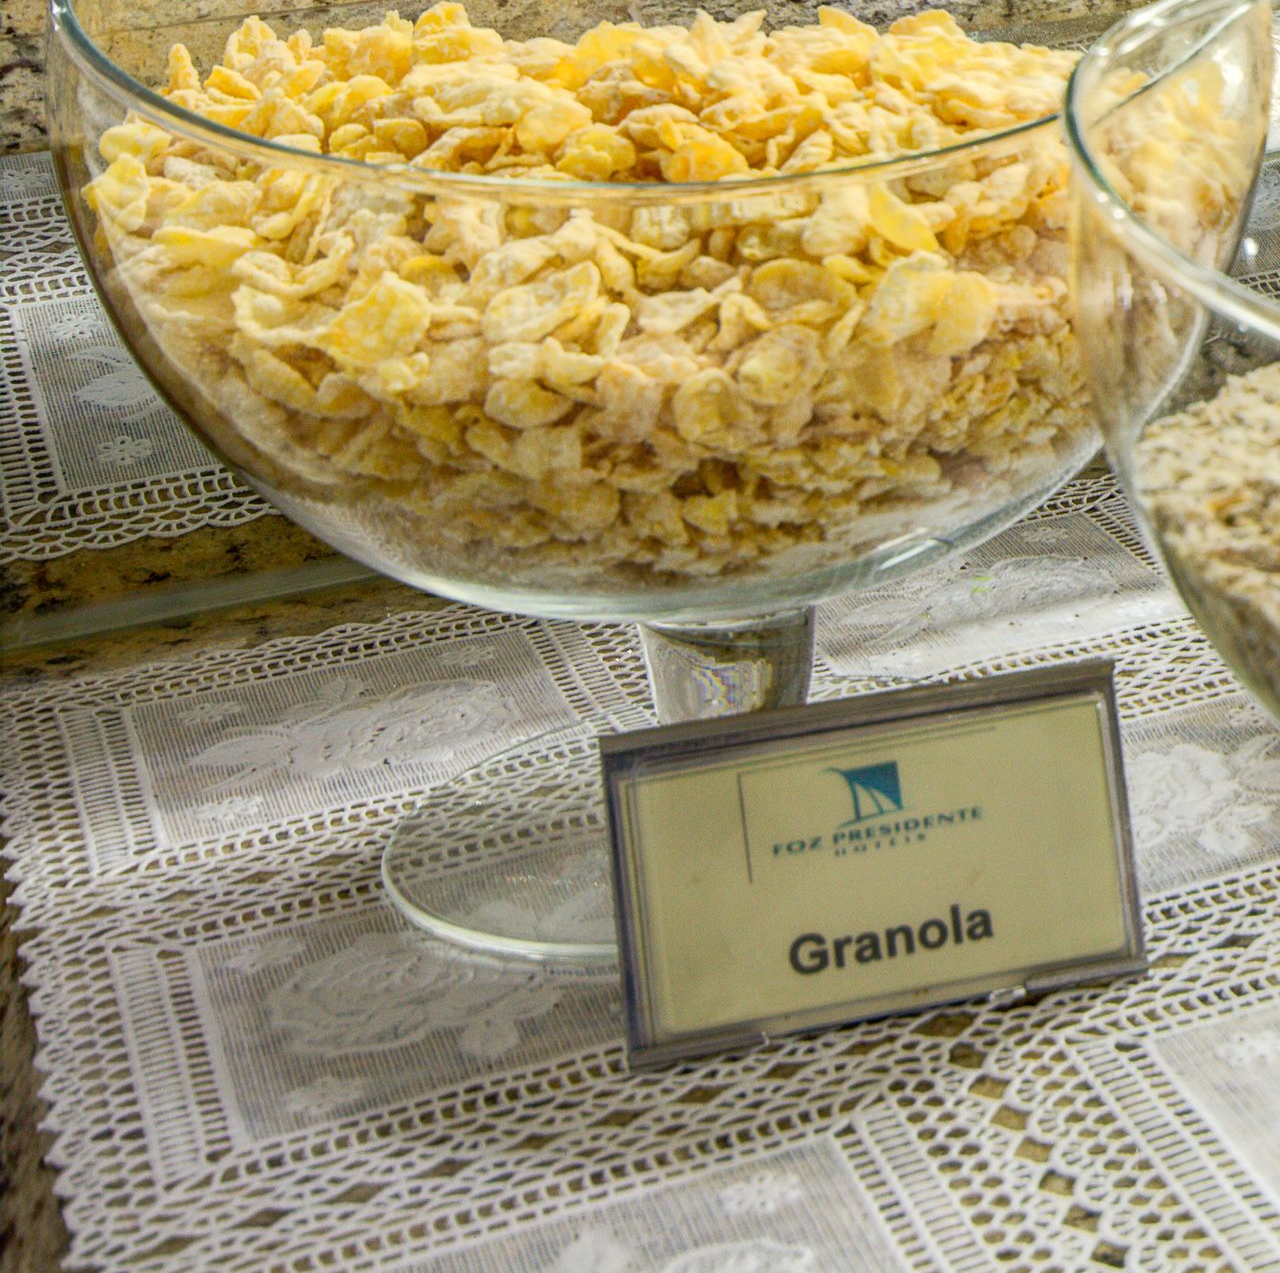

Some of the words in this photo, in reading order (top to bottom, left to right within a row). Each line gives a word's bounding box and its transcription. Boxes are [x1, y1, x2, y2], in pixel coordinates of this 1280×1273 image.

[772, 835, 822, 857] FOZ
[832, 806, 983, 845] PRESIDENTE
[788, 903, 995, 975] Granola
